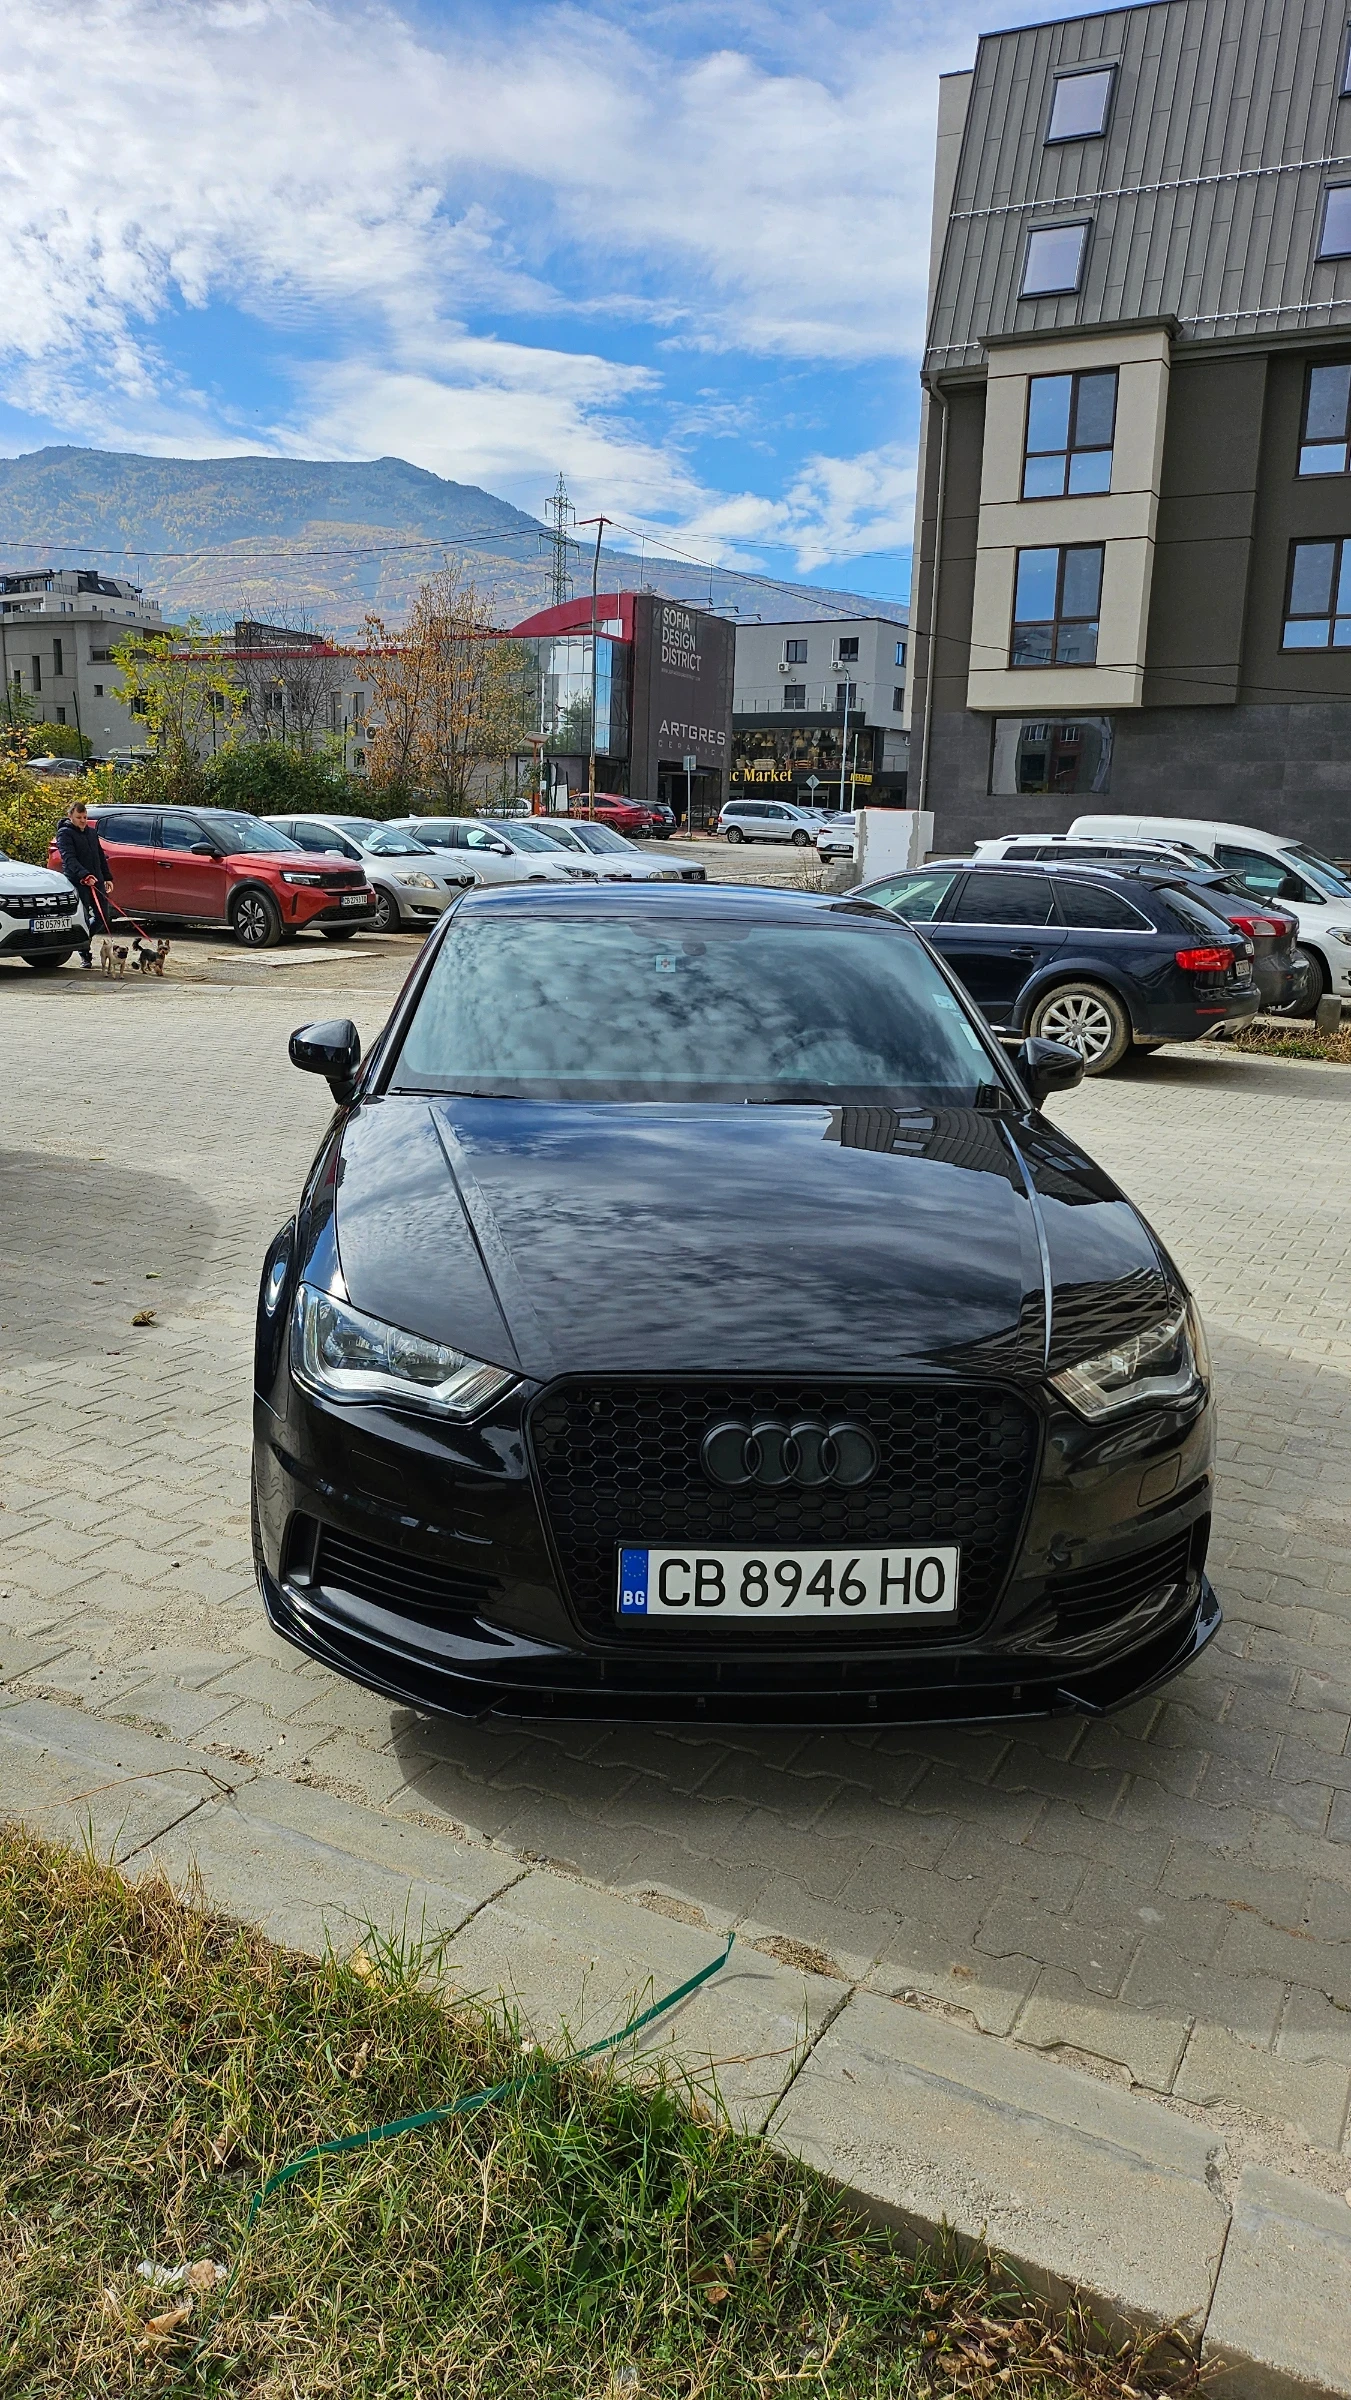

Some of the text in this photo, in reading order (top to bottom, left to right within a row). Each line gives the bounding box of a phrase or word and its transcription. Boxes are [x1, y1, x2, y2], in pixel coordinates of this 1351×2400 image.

[663, 607, 690, 631] SOFIA
[662, 626, 696, 651] DESIGN
[661, 645, 702, 672] DISTRICT
[659, 719, 726, 746] ARTGRES
[743, 768, 793, 782] Market
[35, 921, 44, 930] CB
[658, 1556, 946, 1608] CB 8946 HO
[623, 1590, 645, 1606] BG
